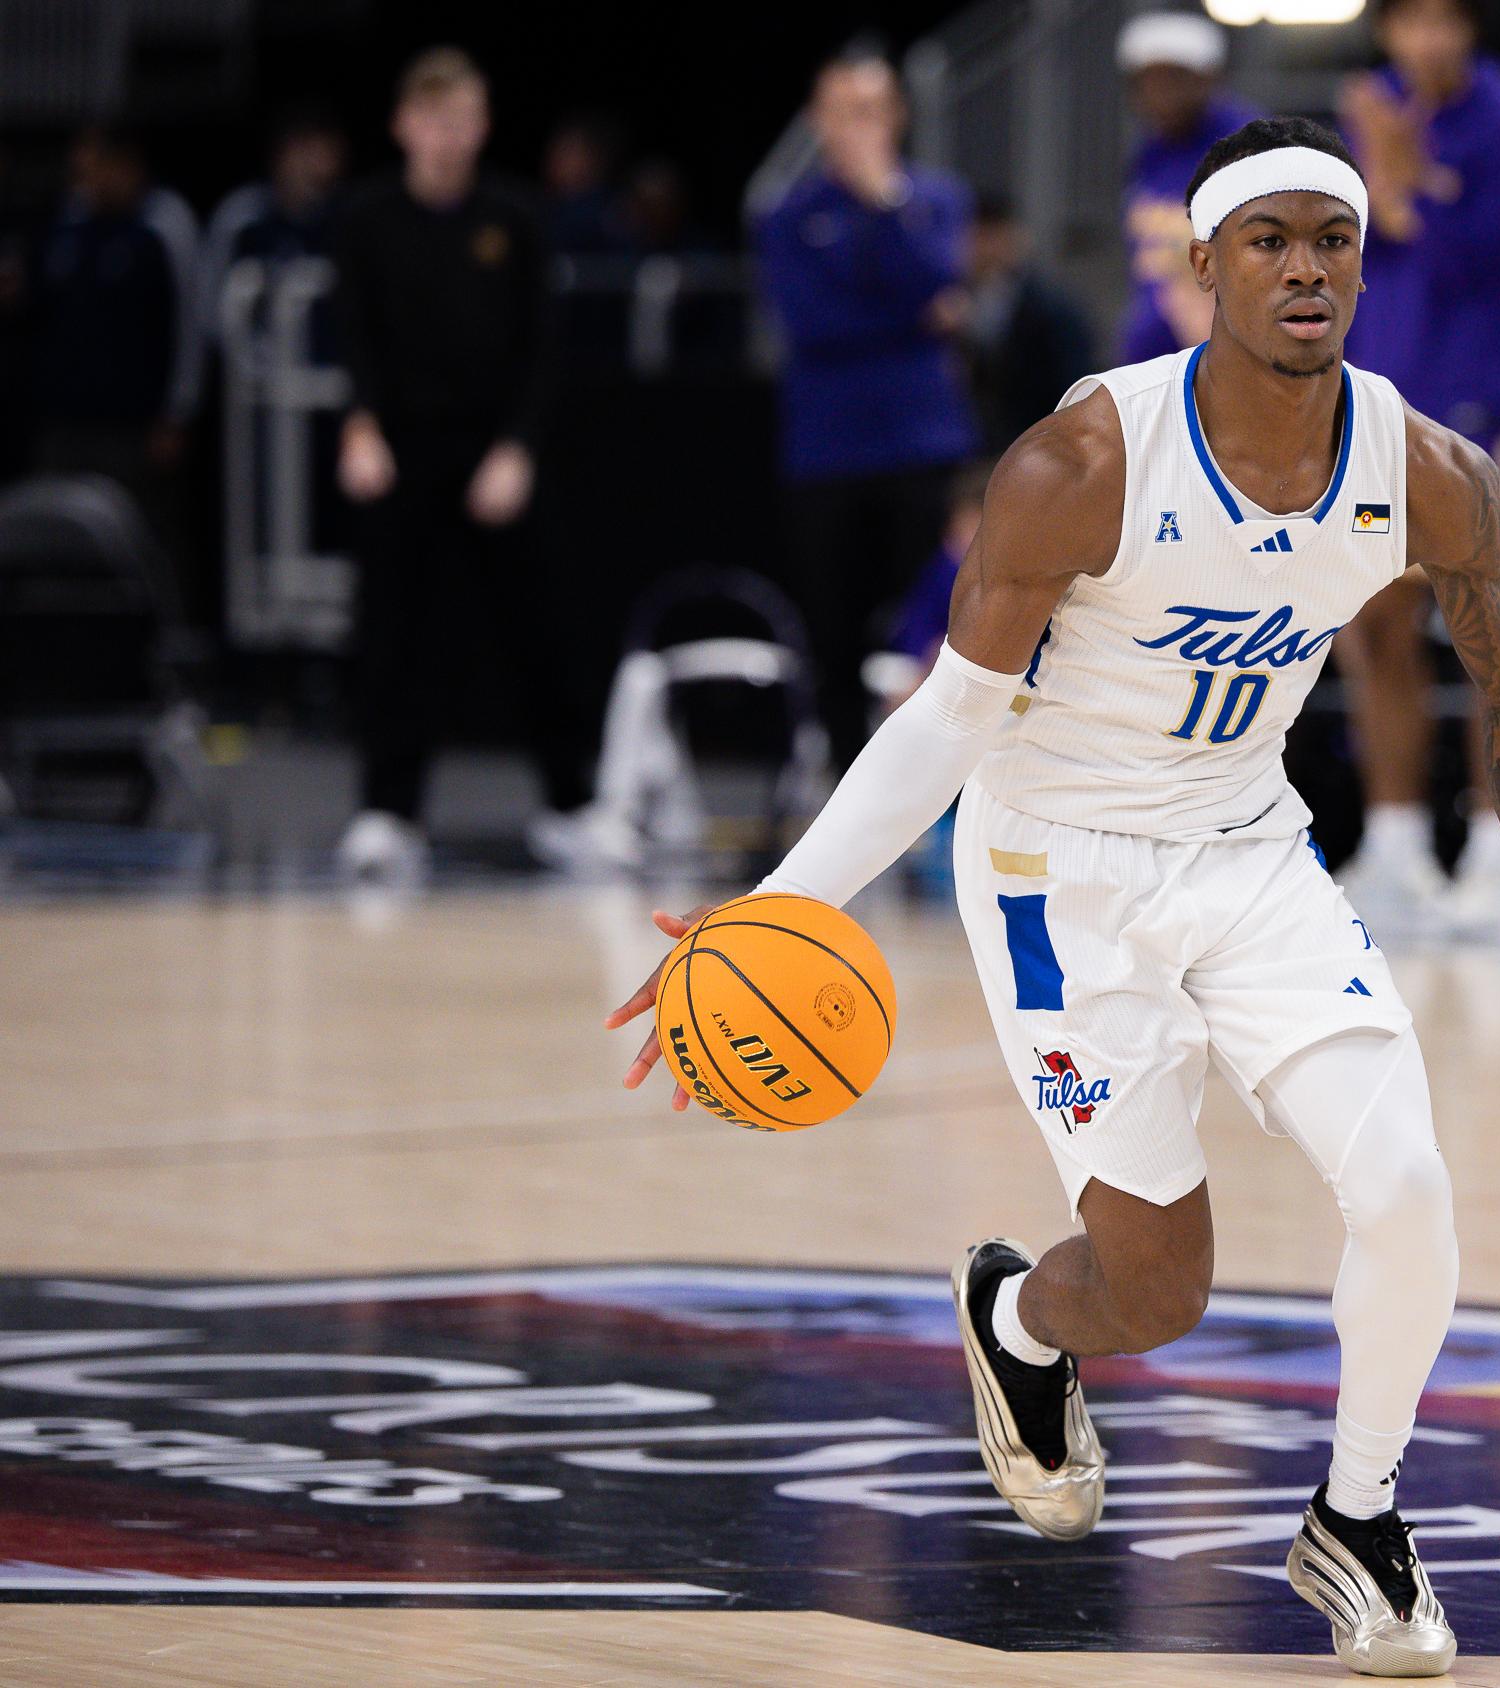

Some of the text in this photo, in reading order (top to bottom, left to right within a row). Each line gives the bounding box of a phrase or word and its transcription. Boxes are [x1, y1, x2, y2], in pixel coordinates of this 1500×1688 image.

[1164, 670, 1273, 746] 10
[710, 1011, 812, 1102] EVO NXT
[1032, 1071, 1111, 1111] Tulsa
